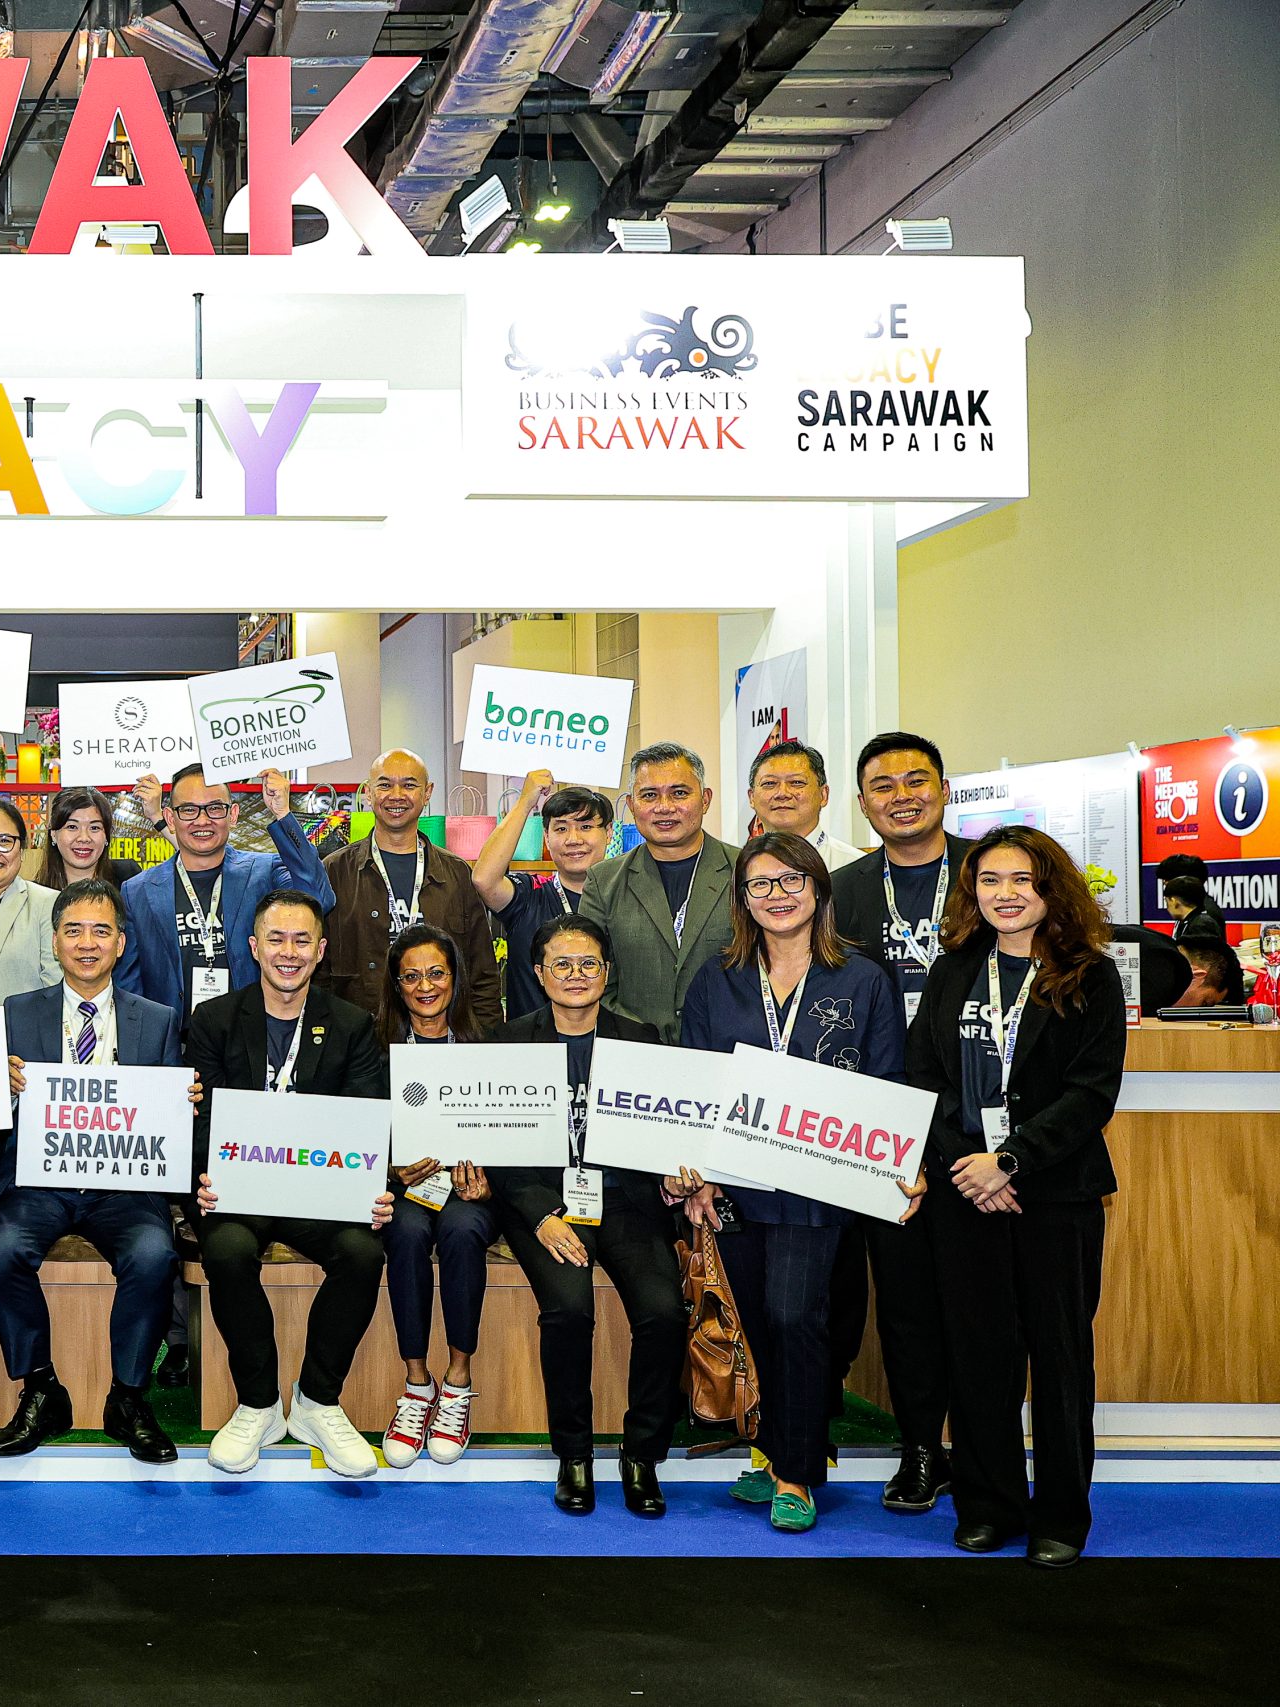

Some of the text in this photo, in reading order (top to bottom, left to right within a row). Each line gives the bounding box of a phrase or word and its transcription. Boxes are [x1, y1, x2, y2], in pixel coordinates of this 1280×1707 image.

[519, 390, 749, 411] BUSINESS EVENTS
[798, 389, 992, 426] SARAWAK
[518, 415, 747, 451] SARAWAK
[798, 432, 994, 451] CAMPAIGN
[210, 705, 306, 739] BORNEO
[485, 692, 609, 736] borneo
[757, 706, 774, 726] AM
[73, 736, 193, 756] SHERATON
[223, 728, 300, 752] CONVENTION
[482, 726, 607, 753] adventure
[114, 758, 151, 770] Kuching
[212, 740, 317, 768] CENTRE KUCHING
[1154, 766, 1172, 784] THE
[954, 790, 959, 804] &
[960, 786, 994, 803] EXHIBITOR
[996, 784, 1009, 798] LIST
[1154, 780, 1198, 800] MEETINGS
[1154, 797, 1198, 824] SHOW
[109, 838, 142, 862] HERE
[46, 1077, 118, 1104] TRIBE
[440, 1082, 556, 1100] pullman
[44, 1104, 137, 1132] LEGACY
[596, 1108, 632, 1118] BUSINESS
[633, 1114, 662, 1122] EVENTS
[688, 1122, 714, 1130] SUSTAI
[726, 1093, 916, 1168] AI. LEGACY
[44, 1132, 166, 1160] SARAWAK
[218, 1141, 378, 1170] #IAMLEGACY
[722, 1126, 906, 1182] Intelligent Impact Management System
[43, 1158, 167, 1176] CAMPAIGN
